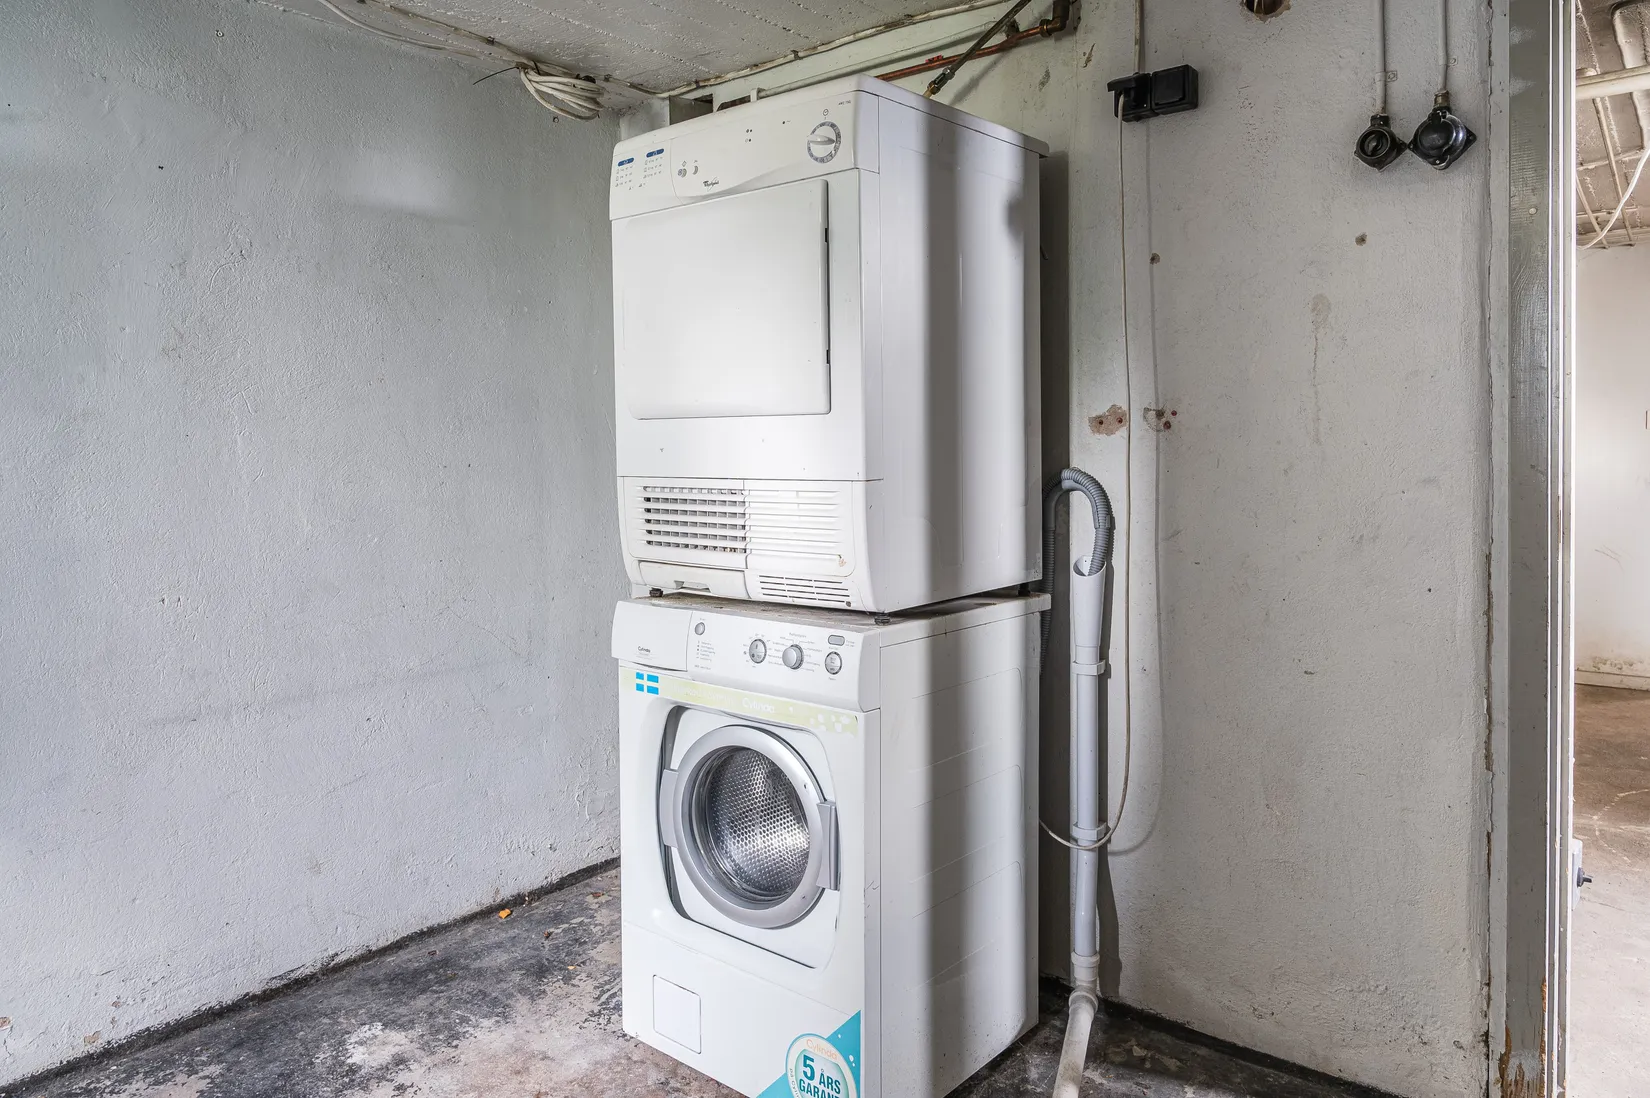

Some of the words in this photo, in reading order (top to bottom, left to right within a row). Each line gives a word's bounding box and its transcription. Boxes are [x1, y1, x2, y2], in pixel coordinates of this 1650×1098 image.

[742, 697, 775, 714] Cylinda
[806, 1039, 838, 1060] Cylinda
[803, 1054, 815, 1081] 5
[819, 1068, 841, 1095] ÅRS
